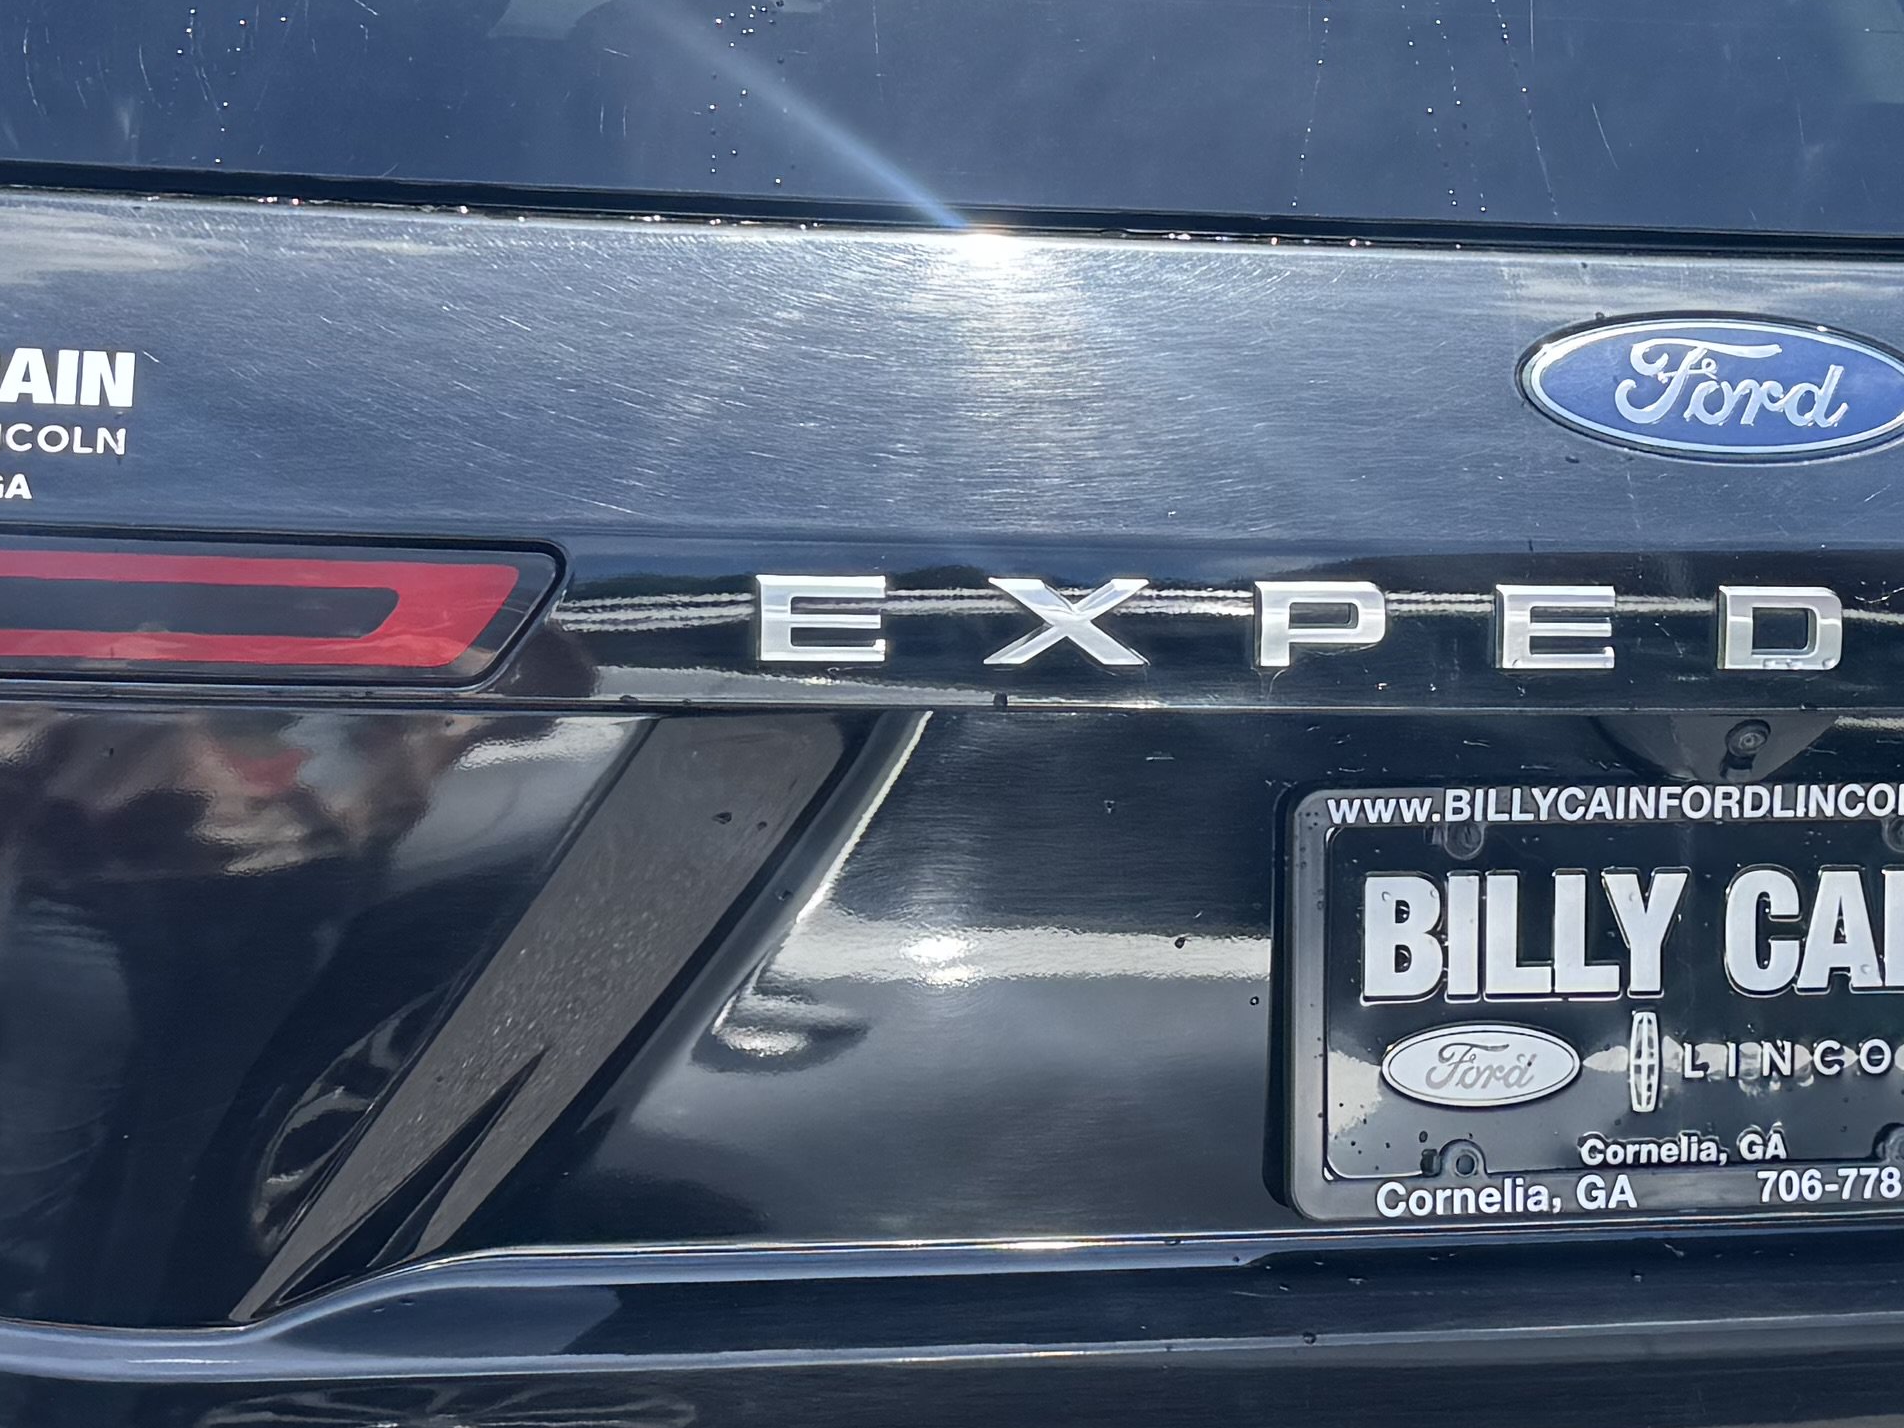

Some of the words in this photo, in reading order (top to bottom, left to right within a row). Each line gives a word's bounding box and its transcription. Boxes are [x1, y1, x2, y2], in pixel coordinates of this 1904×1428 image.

[1615, 337, 1849, 428] Ford
[1362, 868, 1690, 1004] BILLY
[1425, 1042, 1537, 1090] Ford
[1580, 1135, 1728, 1166] Cornelia,
[1739, 1131, 1787, 1161] GA
[1376, 1180, 1562, 1218] Cornelia,
[1578, 1174, 1637, 1211] GA
